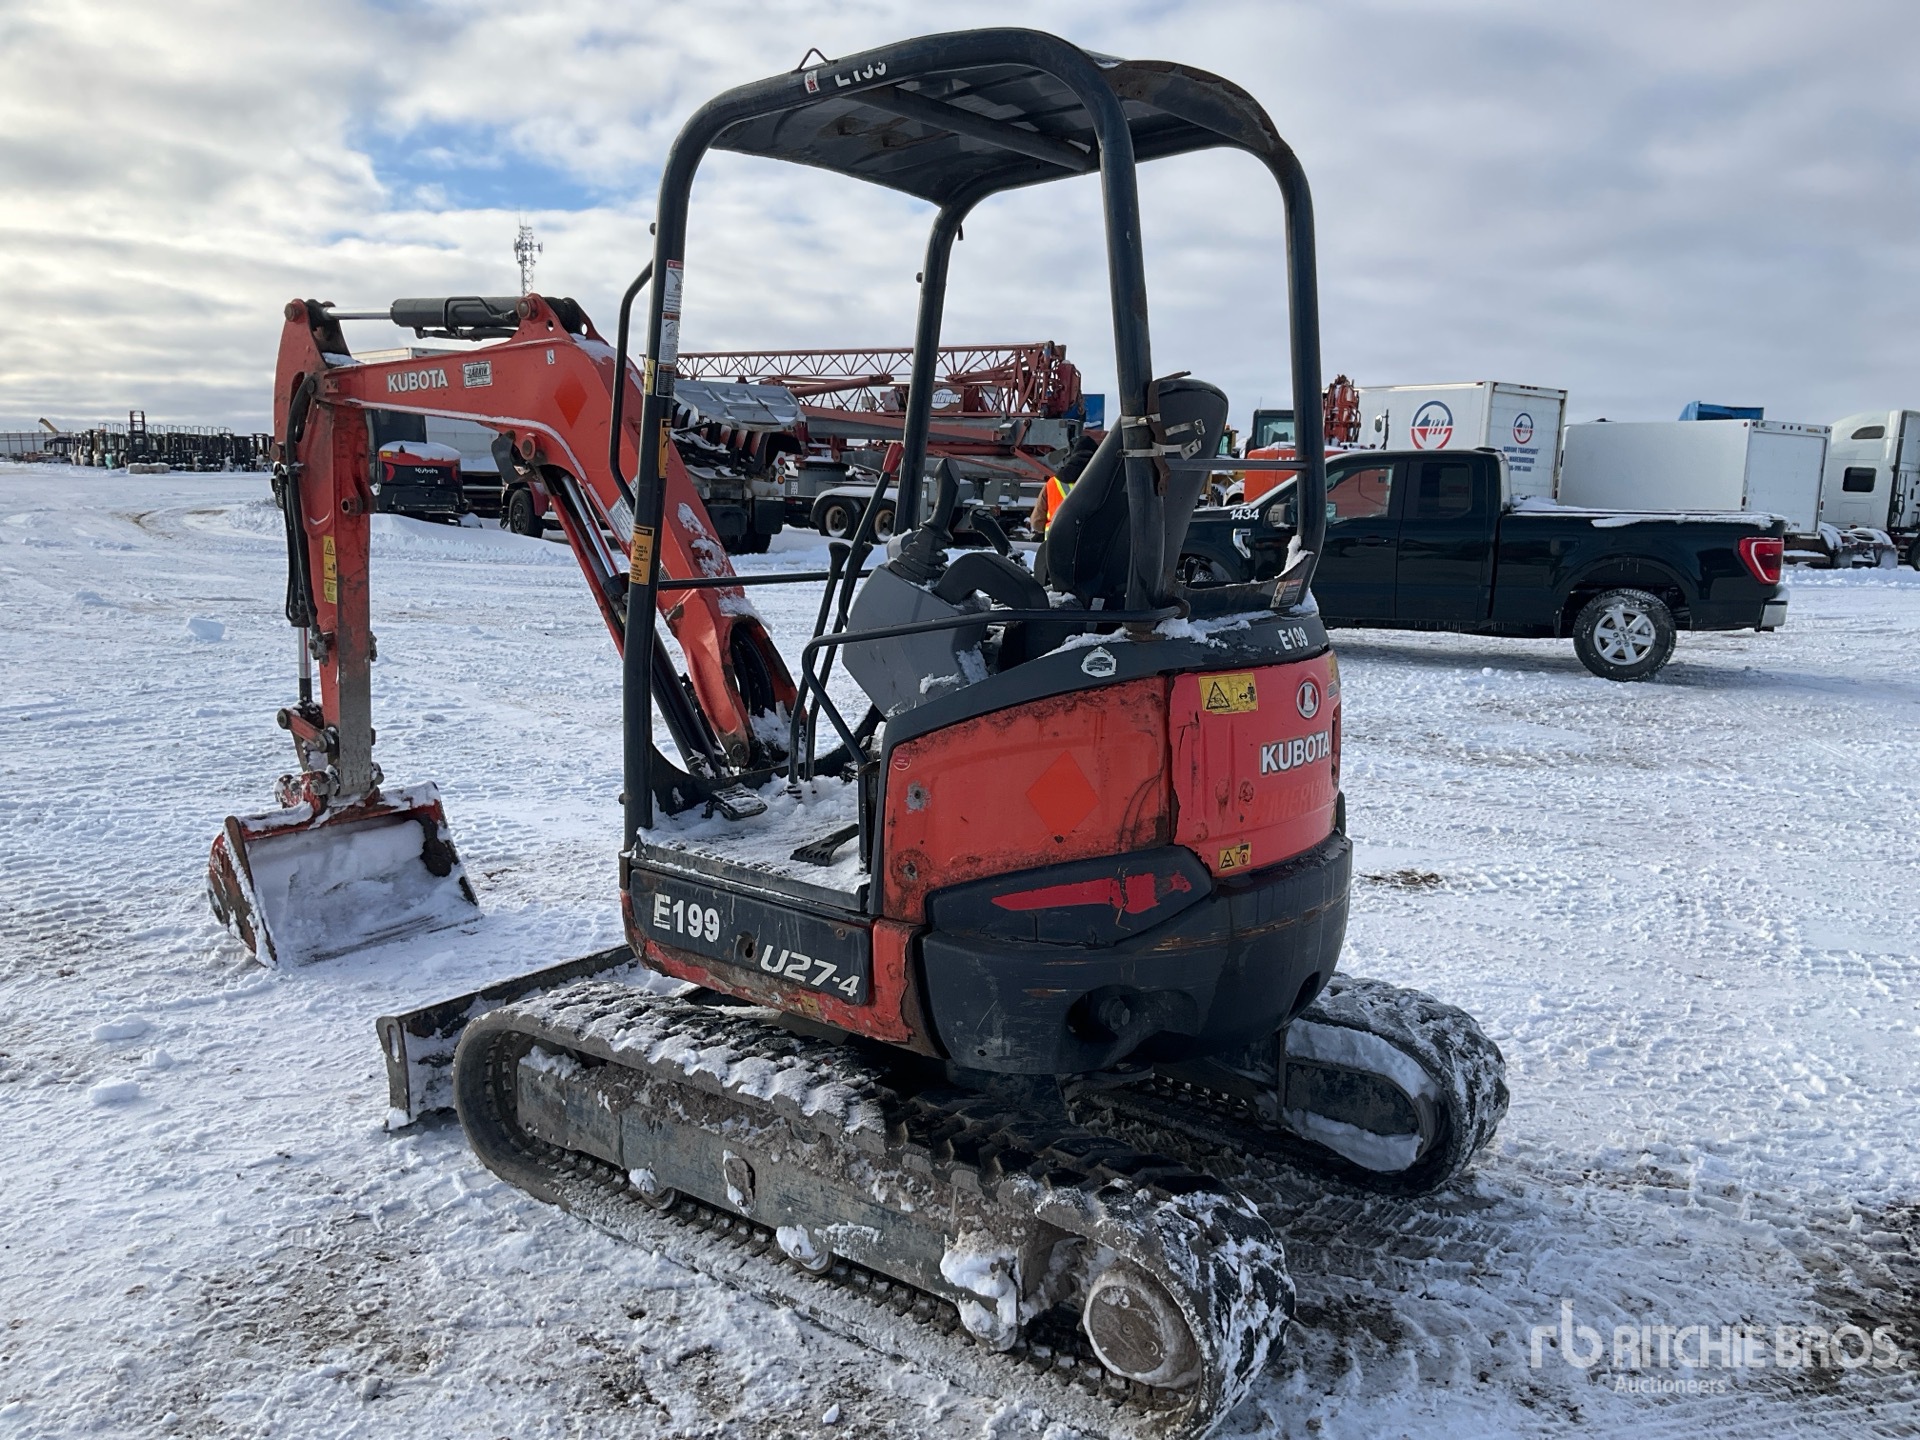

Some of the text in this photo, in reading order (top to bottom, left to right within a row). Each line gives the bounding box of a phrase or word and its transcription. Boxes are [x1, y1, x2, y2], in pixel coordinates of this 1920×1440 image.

[388, 369, 448, 392] KUBOTA
[415, 467, 439, 475] Kubota
[1230, 508, 1259, 520] 1434
[1278, 626, 1309, 650] E199
[1261, 730, 1330, 774] KUBOTA
[653, 892, 720, 943] E199
[760, 944, 860, 997] U27-4
